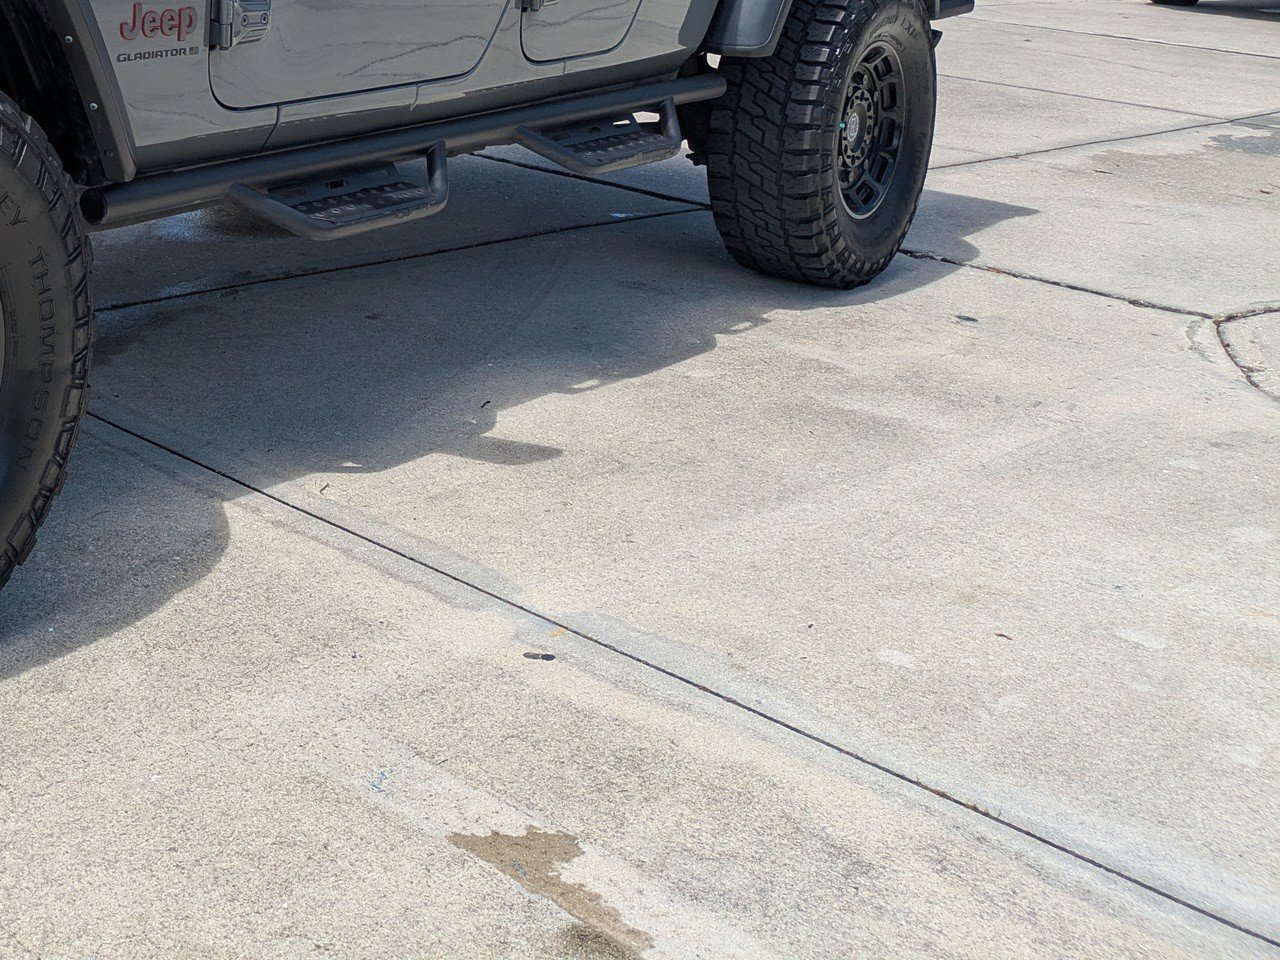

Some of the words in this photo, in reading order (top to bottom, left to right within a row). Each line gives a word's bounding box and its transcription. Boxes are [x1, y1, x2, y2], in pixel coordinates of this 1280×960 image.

[119, 2, 199, 43] Jeep
[116, 46, 188, 63] GLADIATOR
[27, 245, 57, 473] THOMPSON
